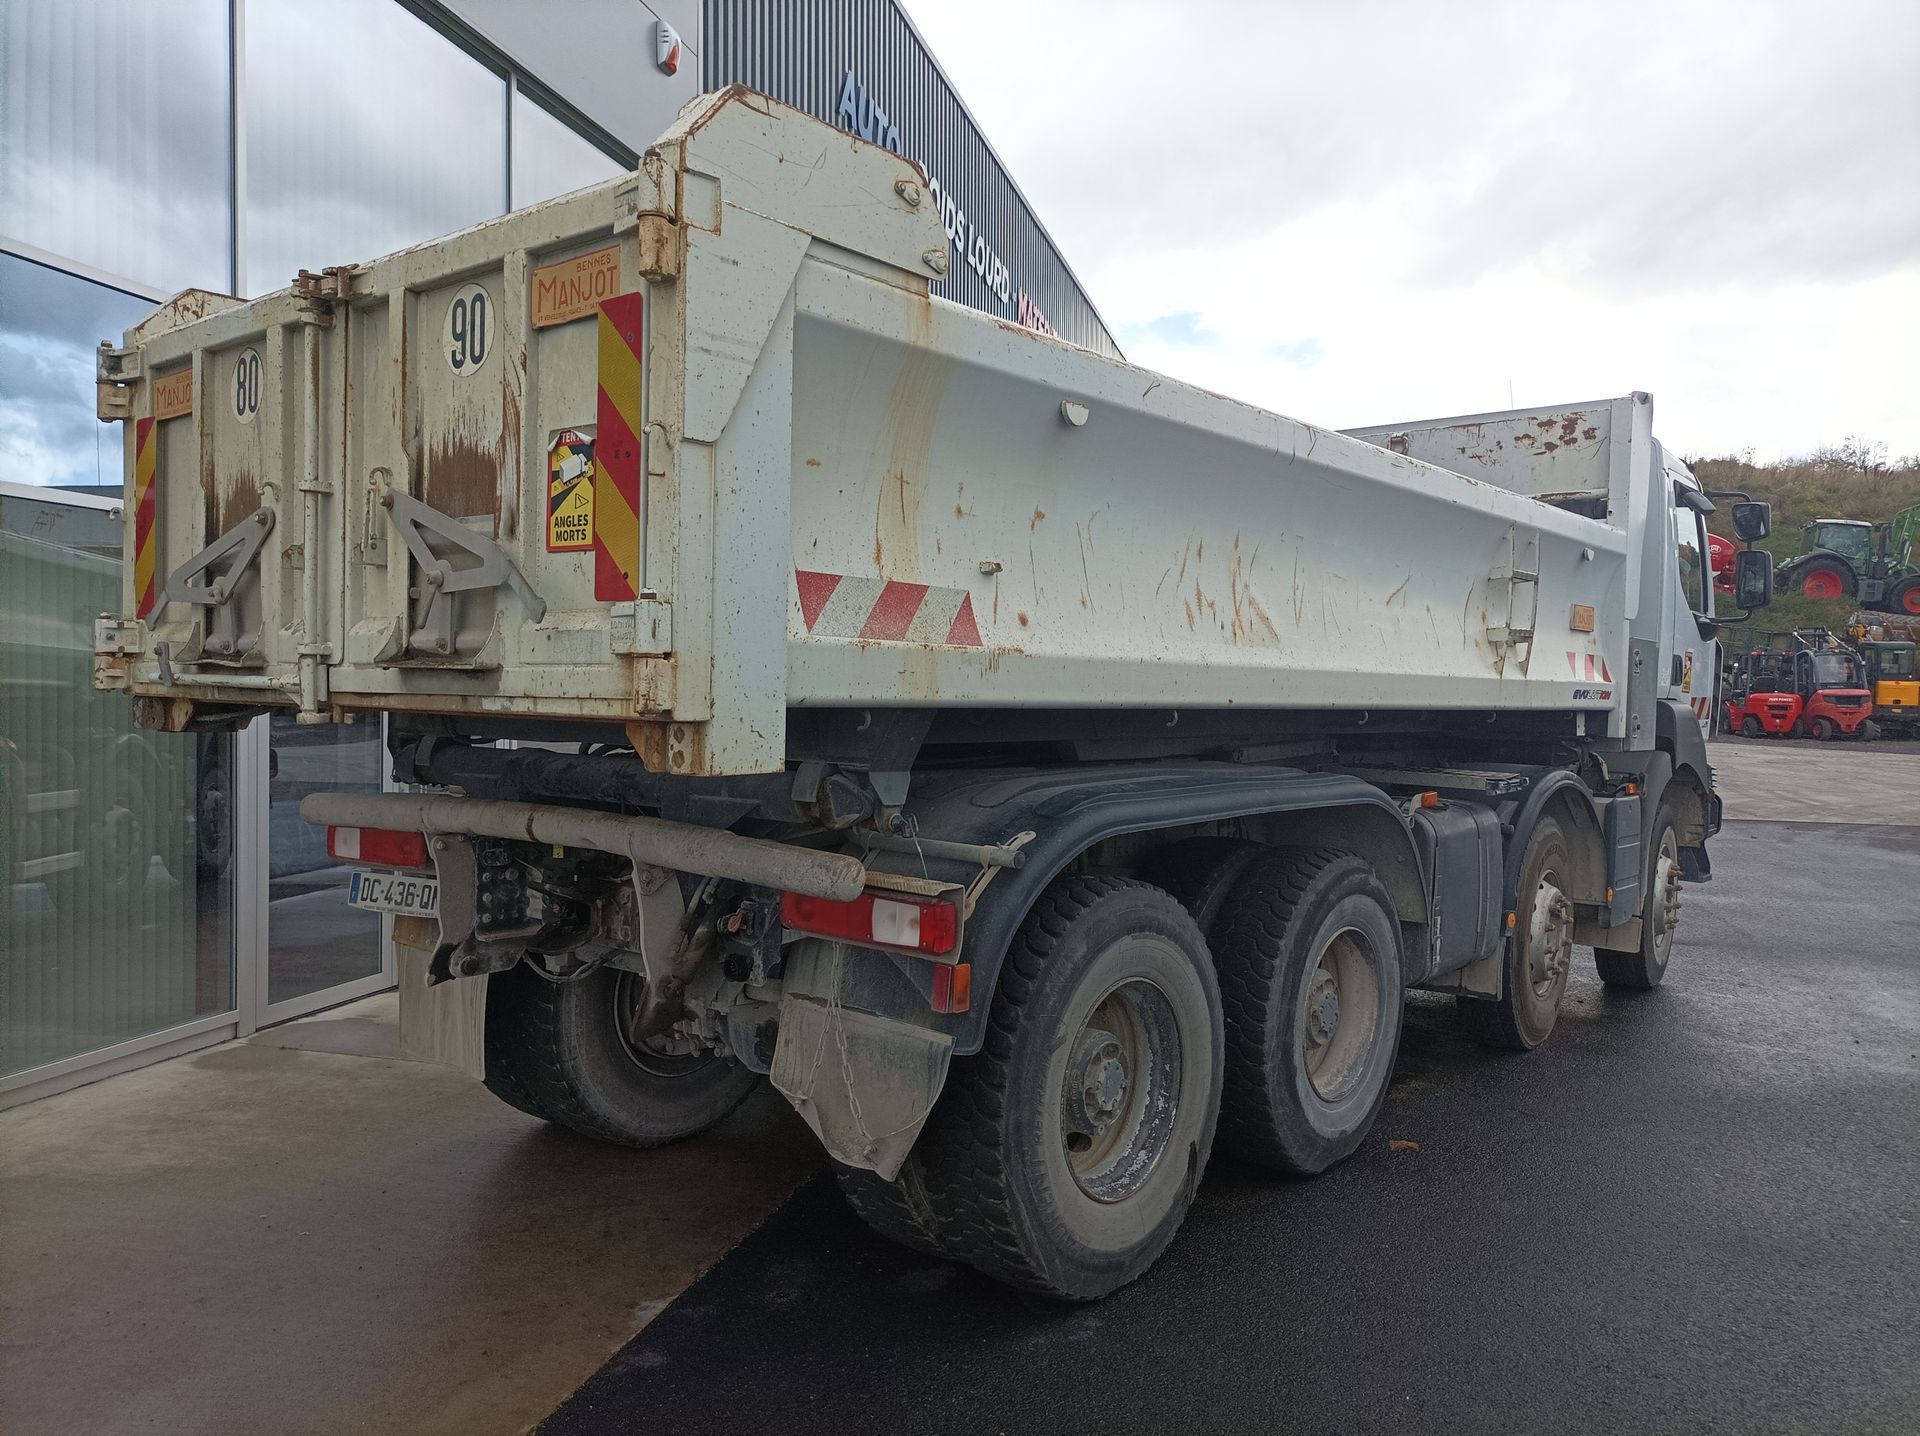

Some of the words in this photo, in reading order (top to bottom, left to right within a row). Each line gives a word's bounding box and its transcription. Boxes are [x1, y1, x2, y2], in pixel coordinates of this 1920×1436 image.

[839, 70, 901, 153] AUTO
[576, 253, 612, 273] BENNES
[966, 223, 1010, 304] LOURD
[537, 264, 618, 314] MANJOT
[451, 292, 486, 370] 90
[156, 382, 193, 412] MANJO
[236, 353, 259, 417] 80
[554, 514, 589, 528] ANGLES
[555, 528, 587, 542] MORTS
